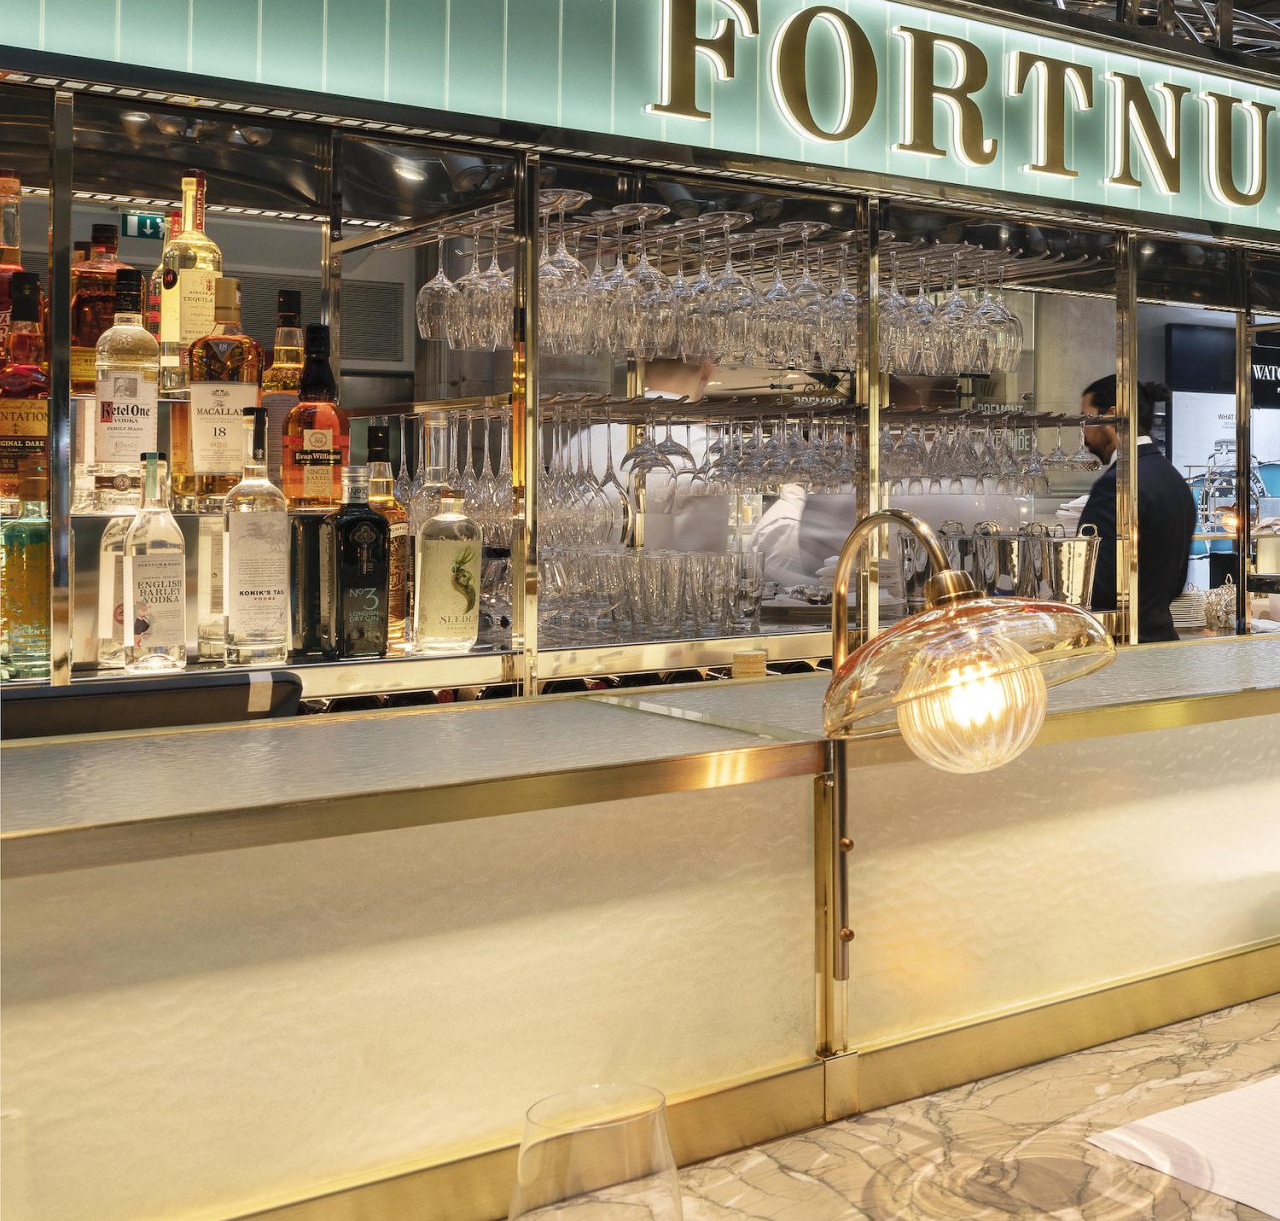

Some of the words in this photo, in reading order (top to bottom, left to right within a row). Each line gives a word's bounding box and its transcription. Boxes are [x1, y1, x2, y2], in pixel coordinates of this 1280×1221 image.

[101, 402, 129, 422] Ketel
[131, 404, 151, 417] One
[1217, 413, 1235, 421] WHAT
[212, 426, 227, 438] 18
[295, 451, 312, 460] Evan
[137, 579, 182, 589] ENGLISH
[139, 588, 182, 597] BARLEY
[144, 595, 180, 604] VODKA
